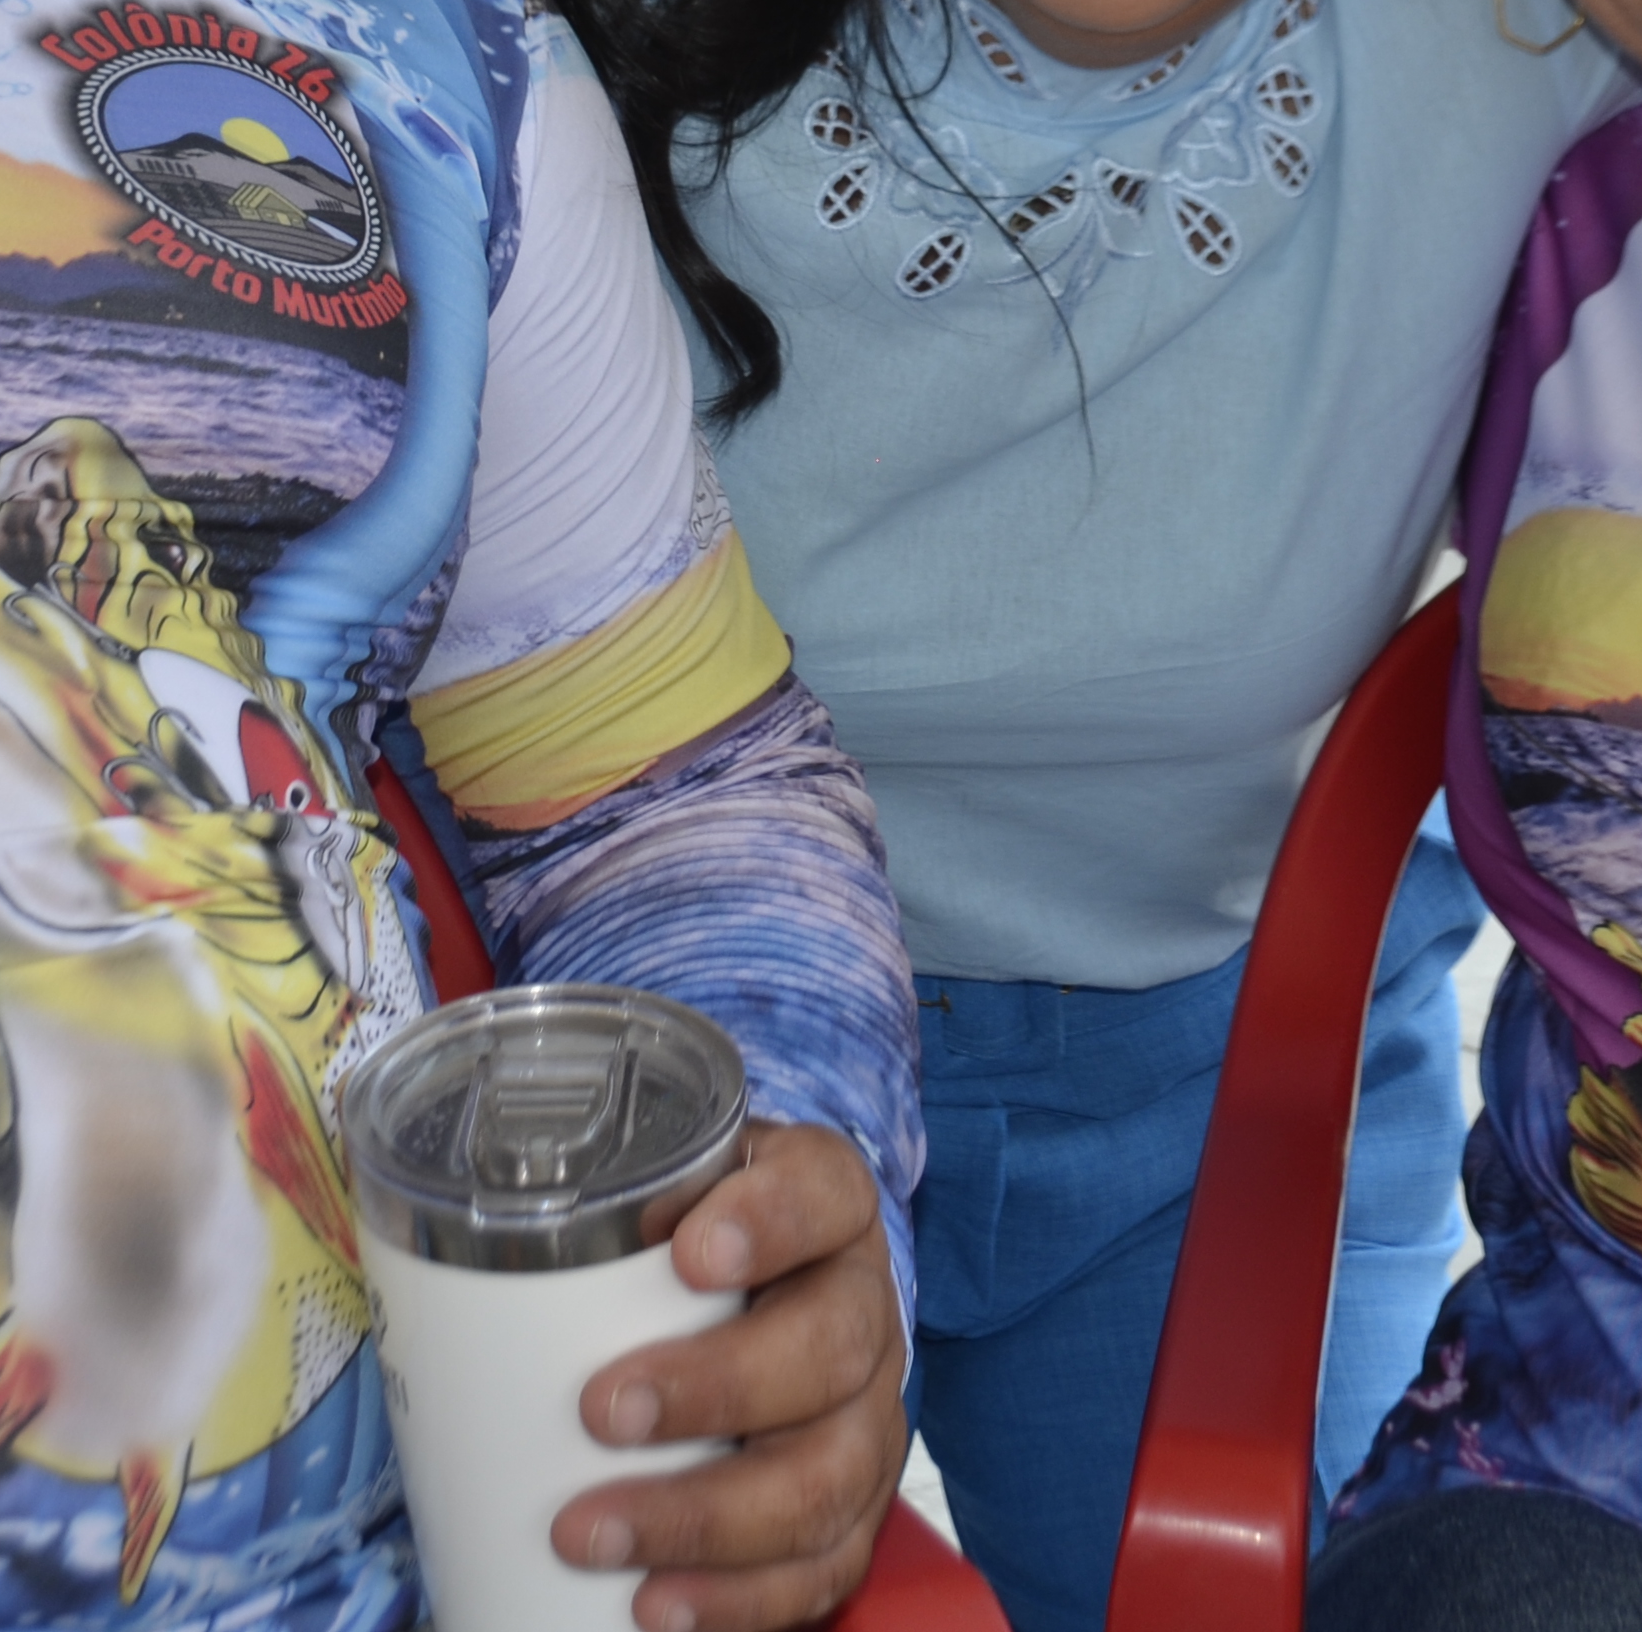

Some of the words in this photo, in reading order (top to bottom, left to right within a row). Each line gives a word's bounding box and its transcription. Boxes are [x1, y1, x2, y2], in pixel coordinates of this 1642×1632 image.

[41, 3, 258, 72] Colônia
[127, 219, 262, 305] Porto
[273, 273, 407, 329] Murtinho
